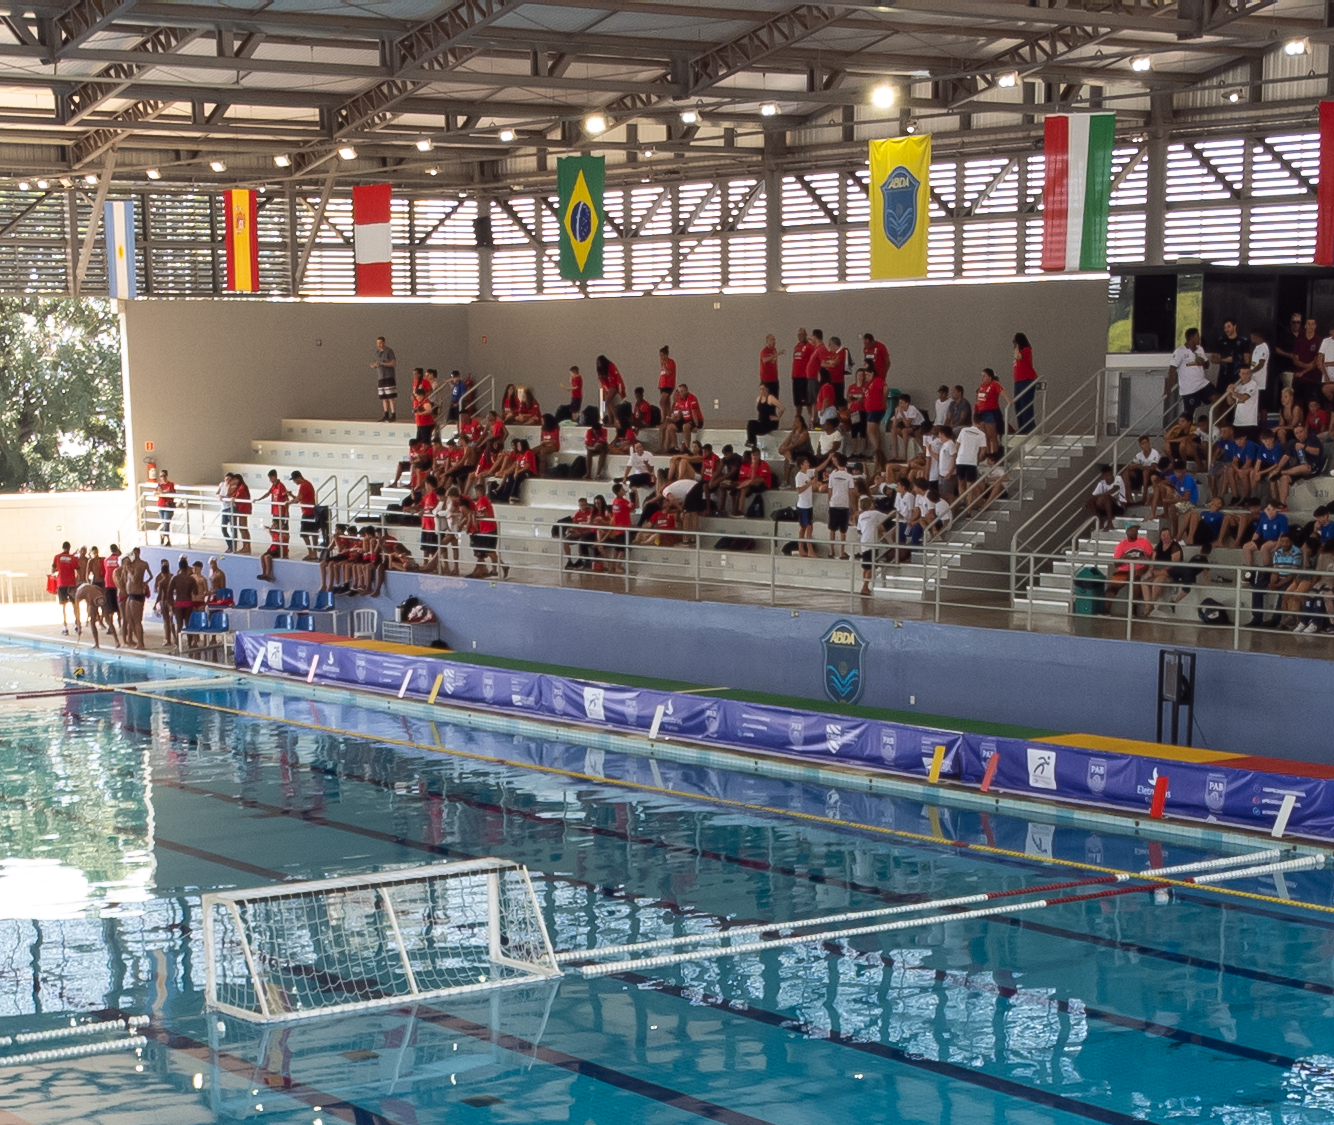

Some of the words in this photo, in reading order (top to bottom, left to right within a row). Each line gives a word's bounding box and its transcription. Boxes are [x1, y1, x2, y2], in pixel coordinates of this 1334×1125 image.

[888, 177, 910, 189] ABDA
[829, 631, 856, 646] ABDA
[1090, 765, 1105, 775] PAB
[1208, 781, 1224, 792] PAB
